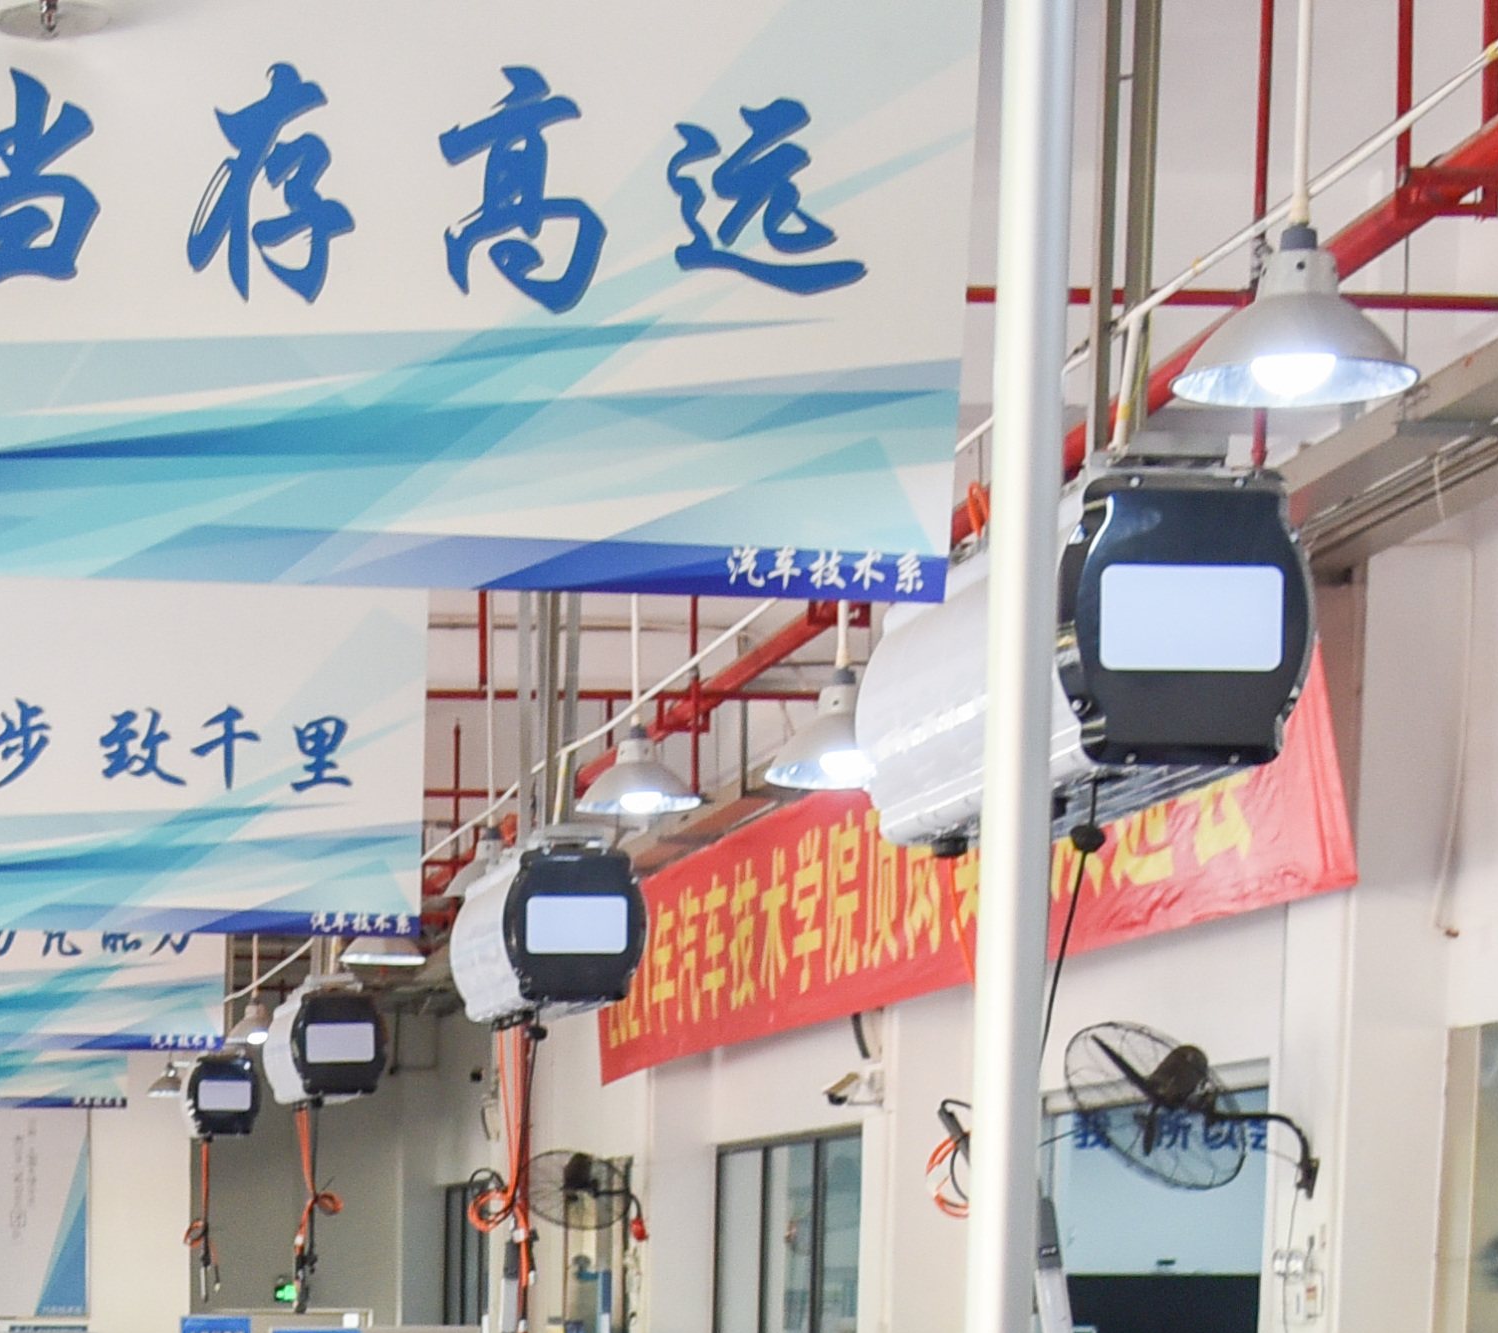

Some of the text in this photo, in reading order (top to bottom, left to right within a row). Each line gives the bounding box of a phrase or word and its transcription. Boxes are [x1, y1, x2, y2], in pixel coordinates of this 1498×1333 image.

[725, 544, 928, 596] 汽车技术系
[98, 705, 353, 792] 致千里
